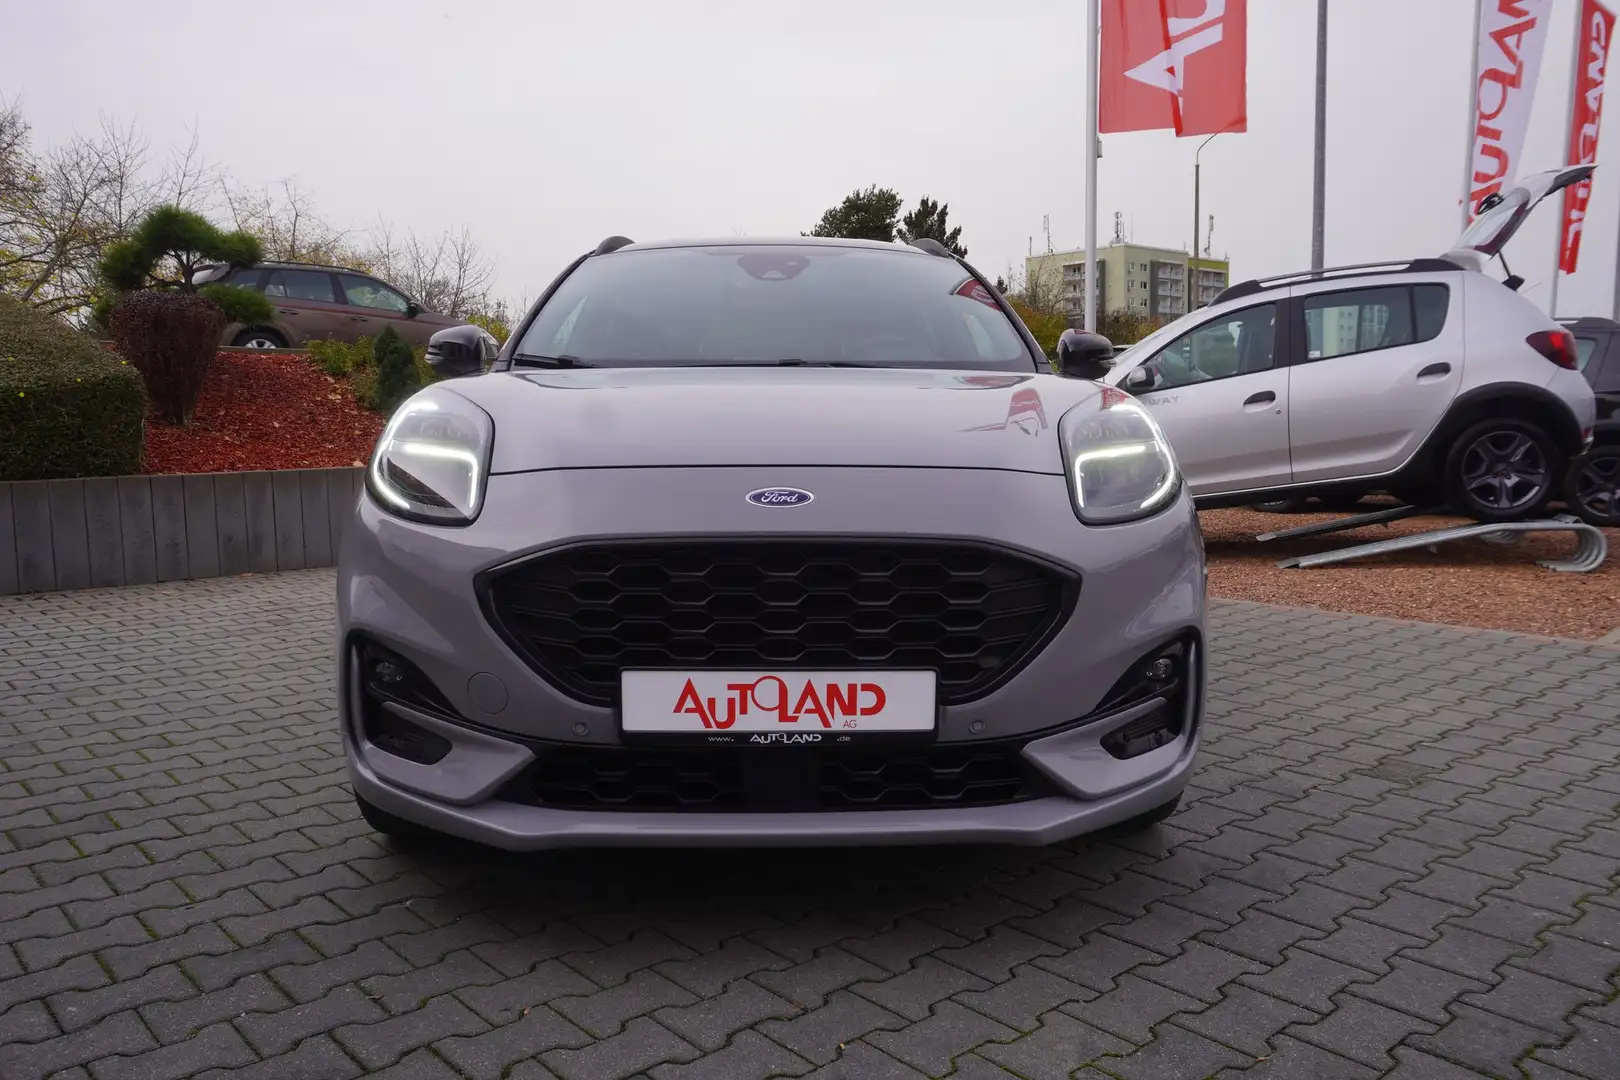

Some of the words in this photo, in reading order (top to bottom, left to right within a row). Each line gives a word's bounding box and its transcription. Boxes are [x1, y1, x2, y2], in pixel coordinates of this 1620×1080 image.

[760, 490, 799, 503] Ford
[673, 675, 887, 729] AUTOLAND
[843, 720, 858, 729] AG
[750, 732, 822, 744] AUTOLAND
